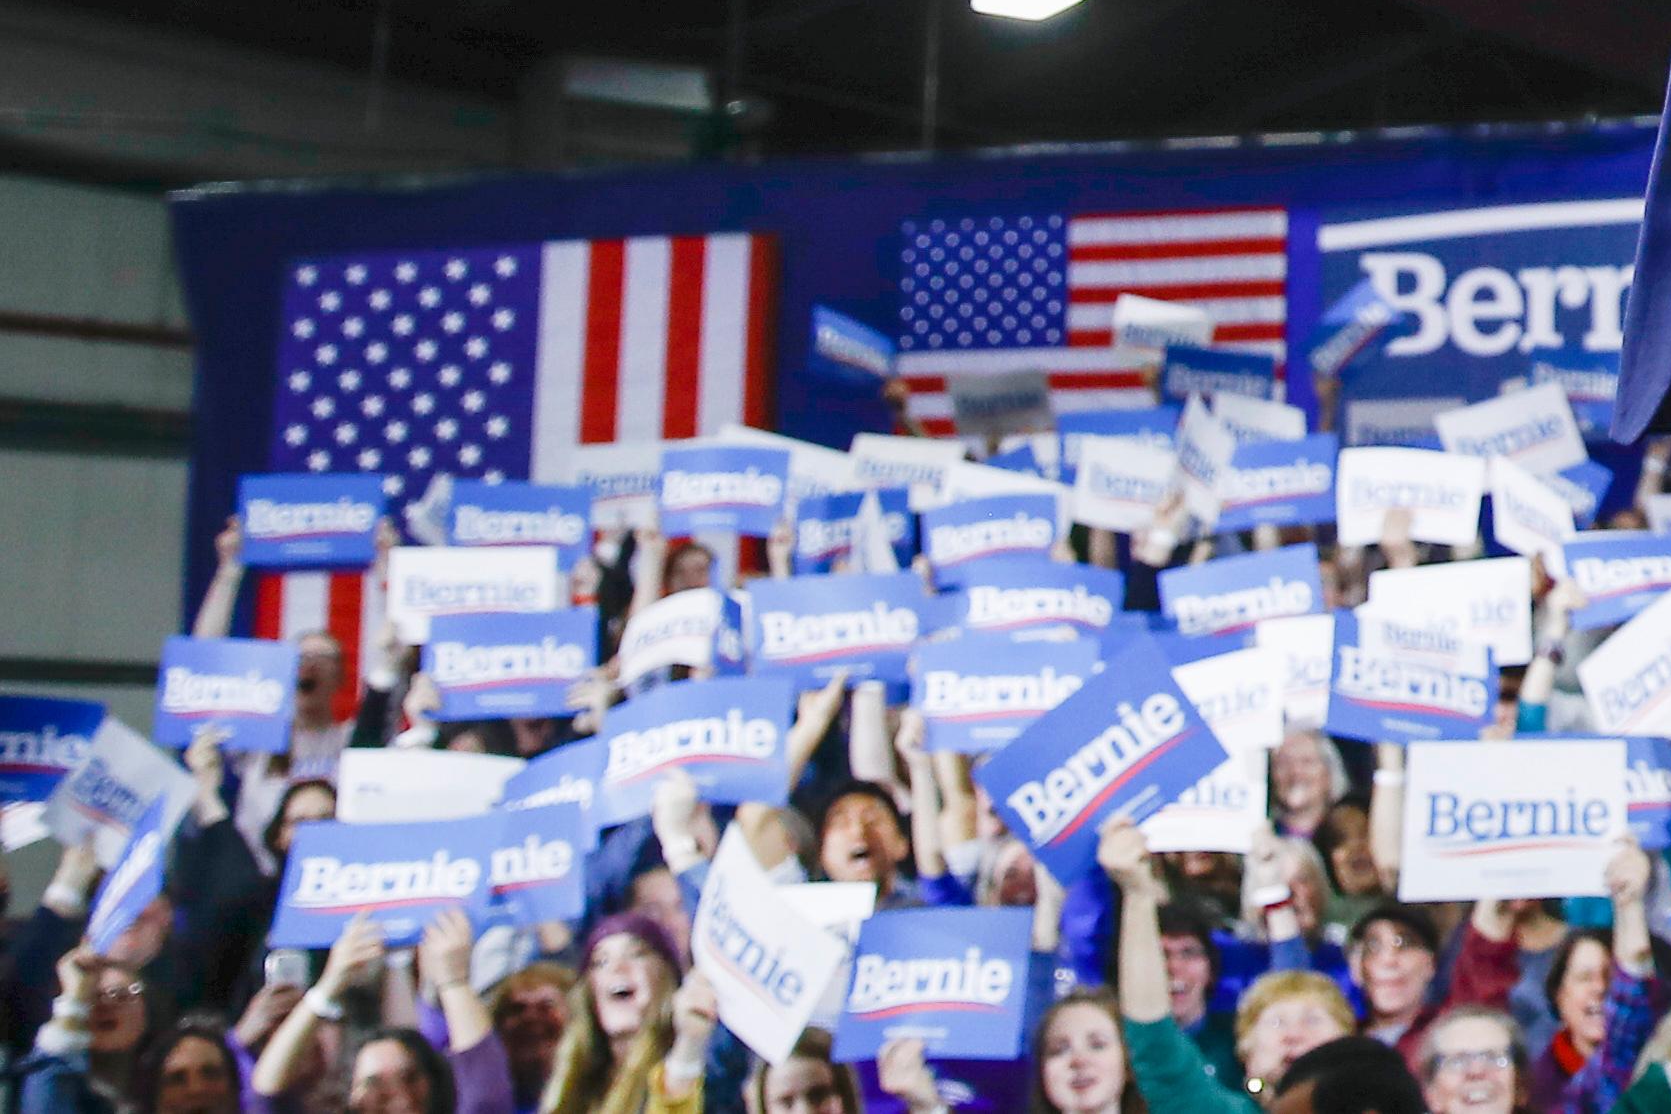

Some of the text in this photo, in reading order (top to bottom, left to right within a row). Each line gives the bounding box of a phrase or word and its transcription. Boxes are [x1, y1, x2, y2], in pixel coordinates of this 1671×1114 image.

[661, 465, 782, 508] Bernie
[1352, 474, 1466, 508] Bernie
[246, 497, 378, 537] Bernie
[454, 505, 586, 544] Bernie
[929, 511, 1052, 562] Bernie
[761, 601, 919, 657] Bernie
[968, 584, 1113, 628] Bernie
[1171, 576, 1313, 635] Bernie
[433, 637, 587, 685] Bernie
[162, 666, 286, 714] Bernie
[604, 708, 778, 782] Bernie
[1005, 693, 1186, 847] Bernie
[1425, 787, 1611, 839] Bernie
[298, 848, 481, 904] Bernie
[850, 946, 1013, 1013] Bernie
